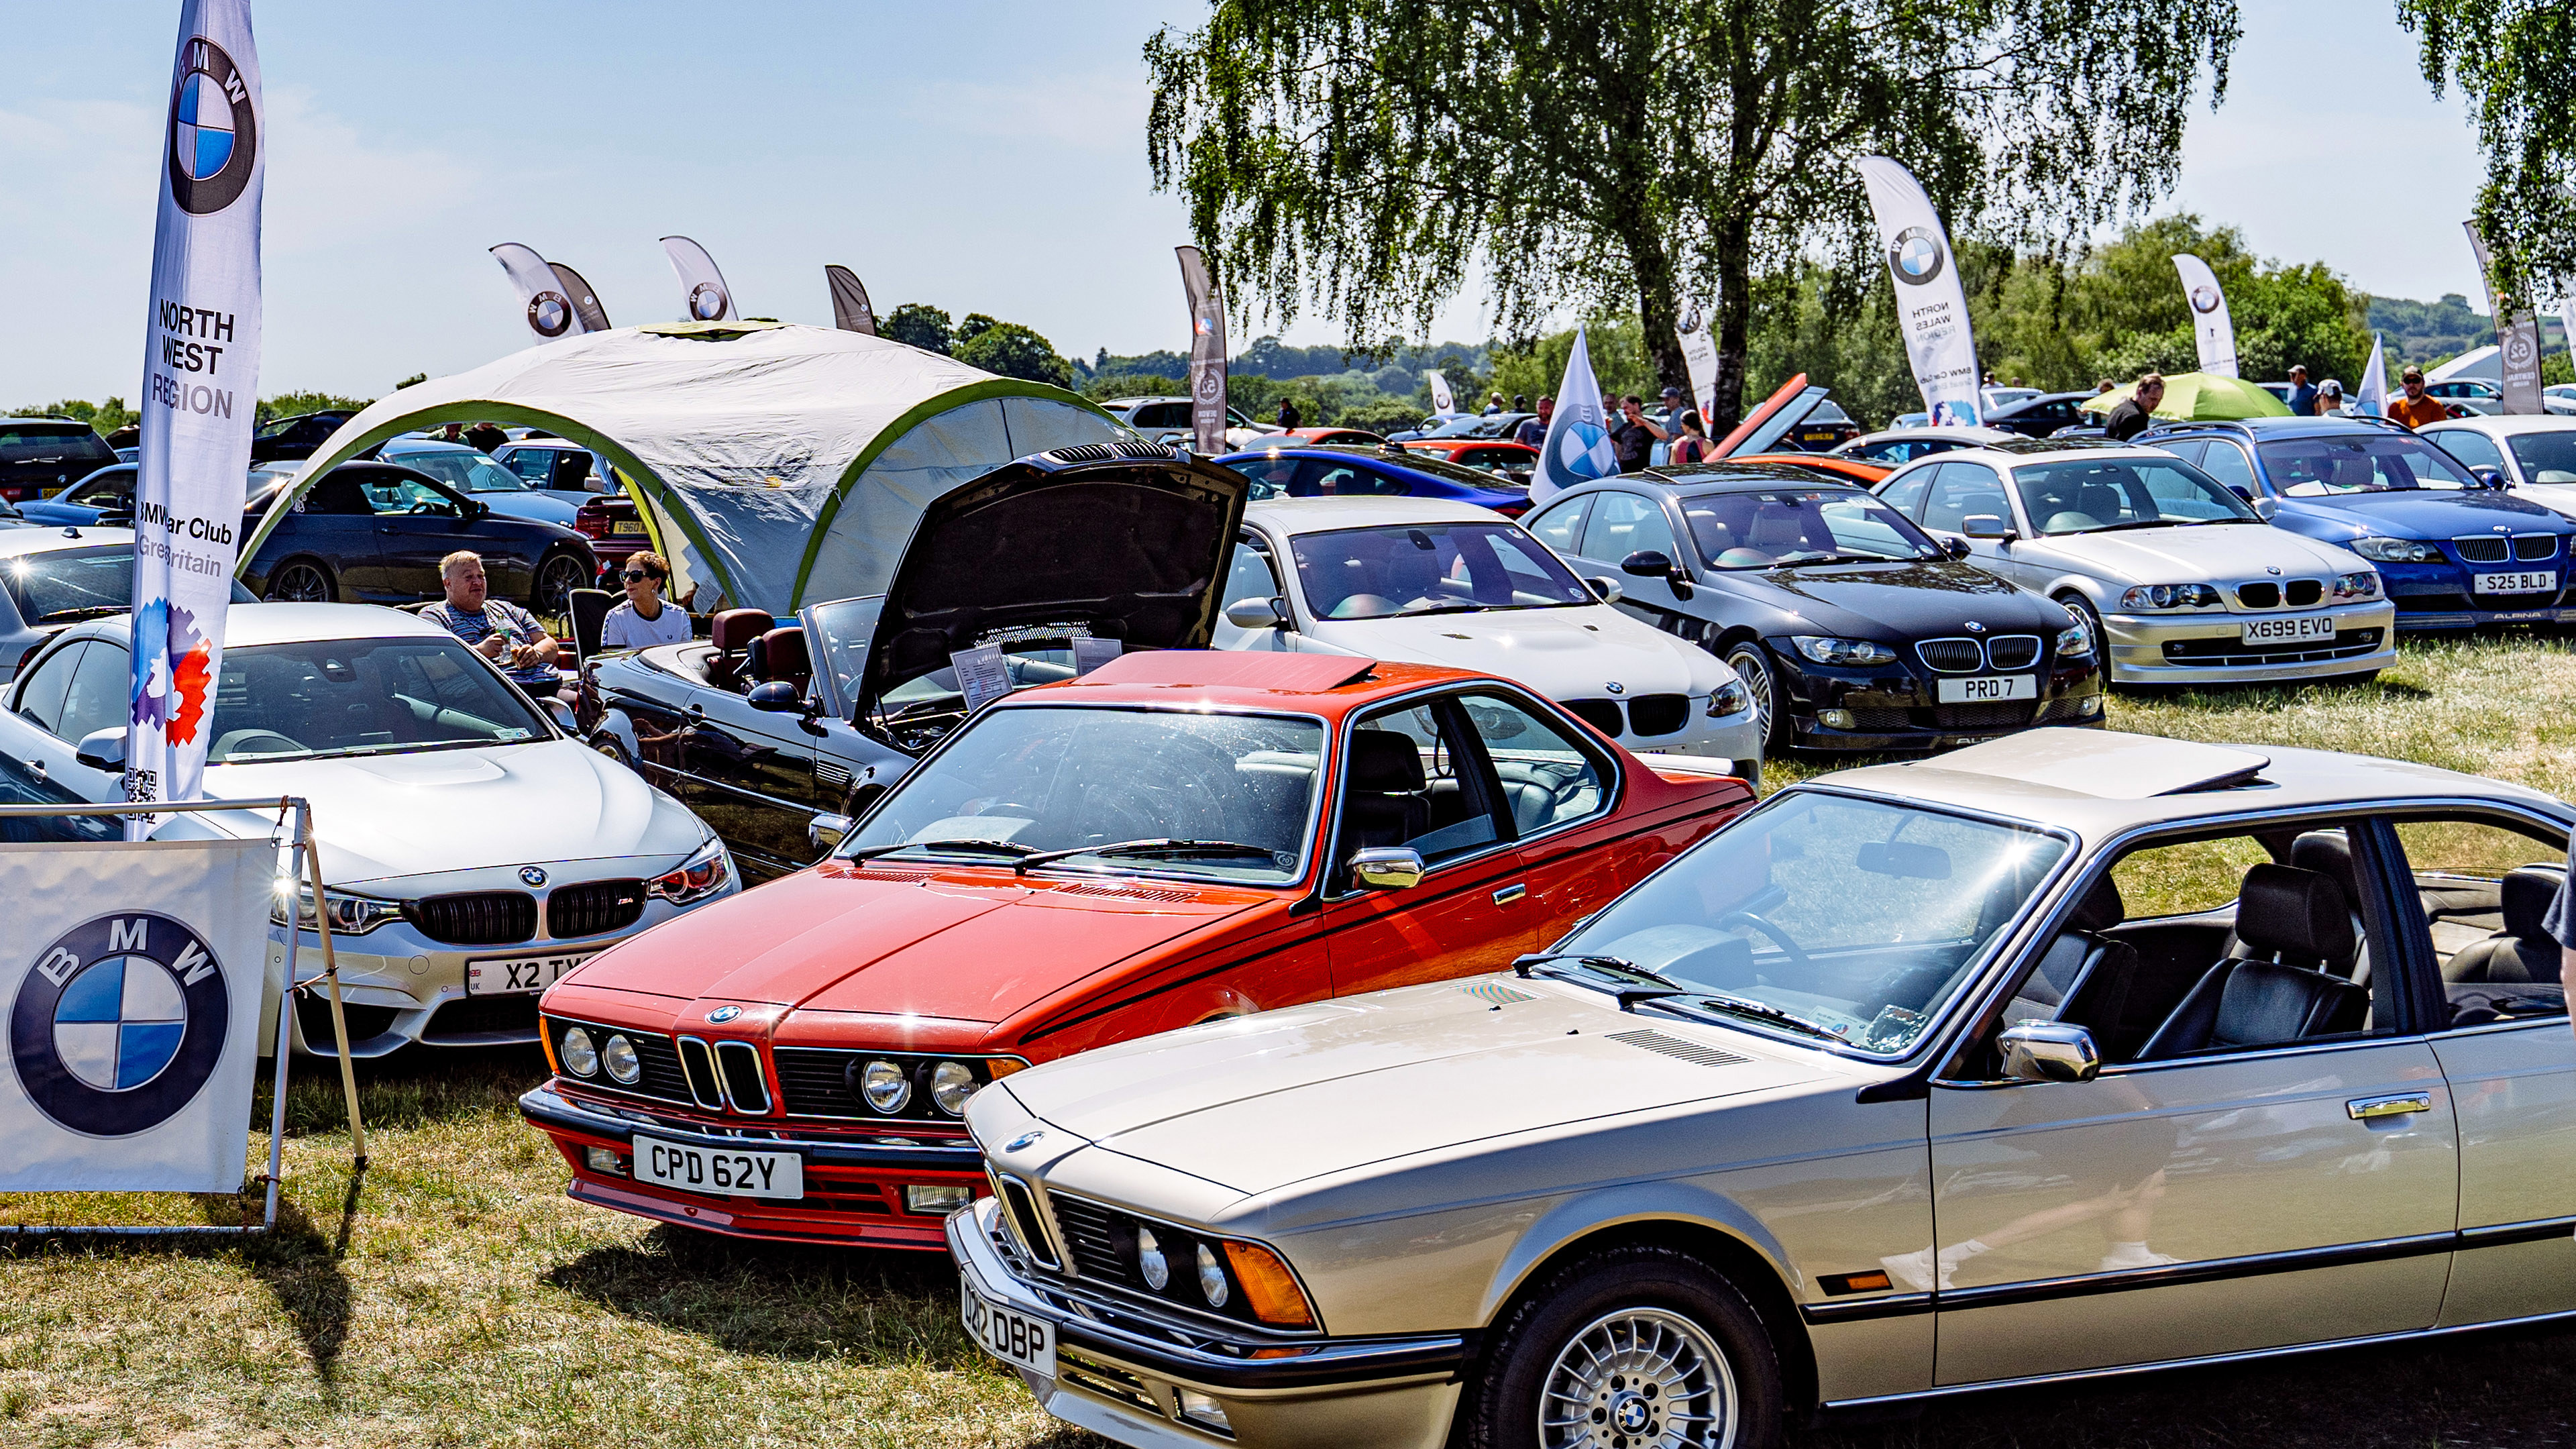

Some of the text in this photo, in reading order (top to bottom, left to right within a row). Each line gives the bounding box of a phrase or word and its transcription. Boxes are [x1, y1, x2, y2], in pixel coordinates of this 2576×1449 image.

[178, 42, 247, 105] BMW
[159, 298, 235, 343] NORTH
[162, 334, 223, 375] WEST
[152, 372, 233, 419] REGION
[167, 517, 185, 535] ar
[189, 517, 232, 545] Club
[617, 522, 639, 532] T960
[2487, 574, 2546, 590] S25 BLD
[2248, 617, 2332, 638] X699 EVO
[1966, 679, 2014, 698] PRD 7
[37, 918, 216, 989] BMW
[470, 982, 480, 991] UK
[506, 957, 590, 990] X2 TY
[652, 1145, 775, 1191] CPD 62Y
[992, 1309, 1044, 1364] DBP
[1619, 1398, 1633, 1428] BMW
